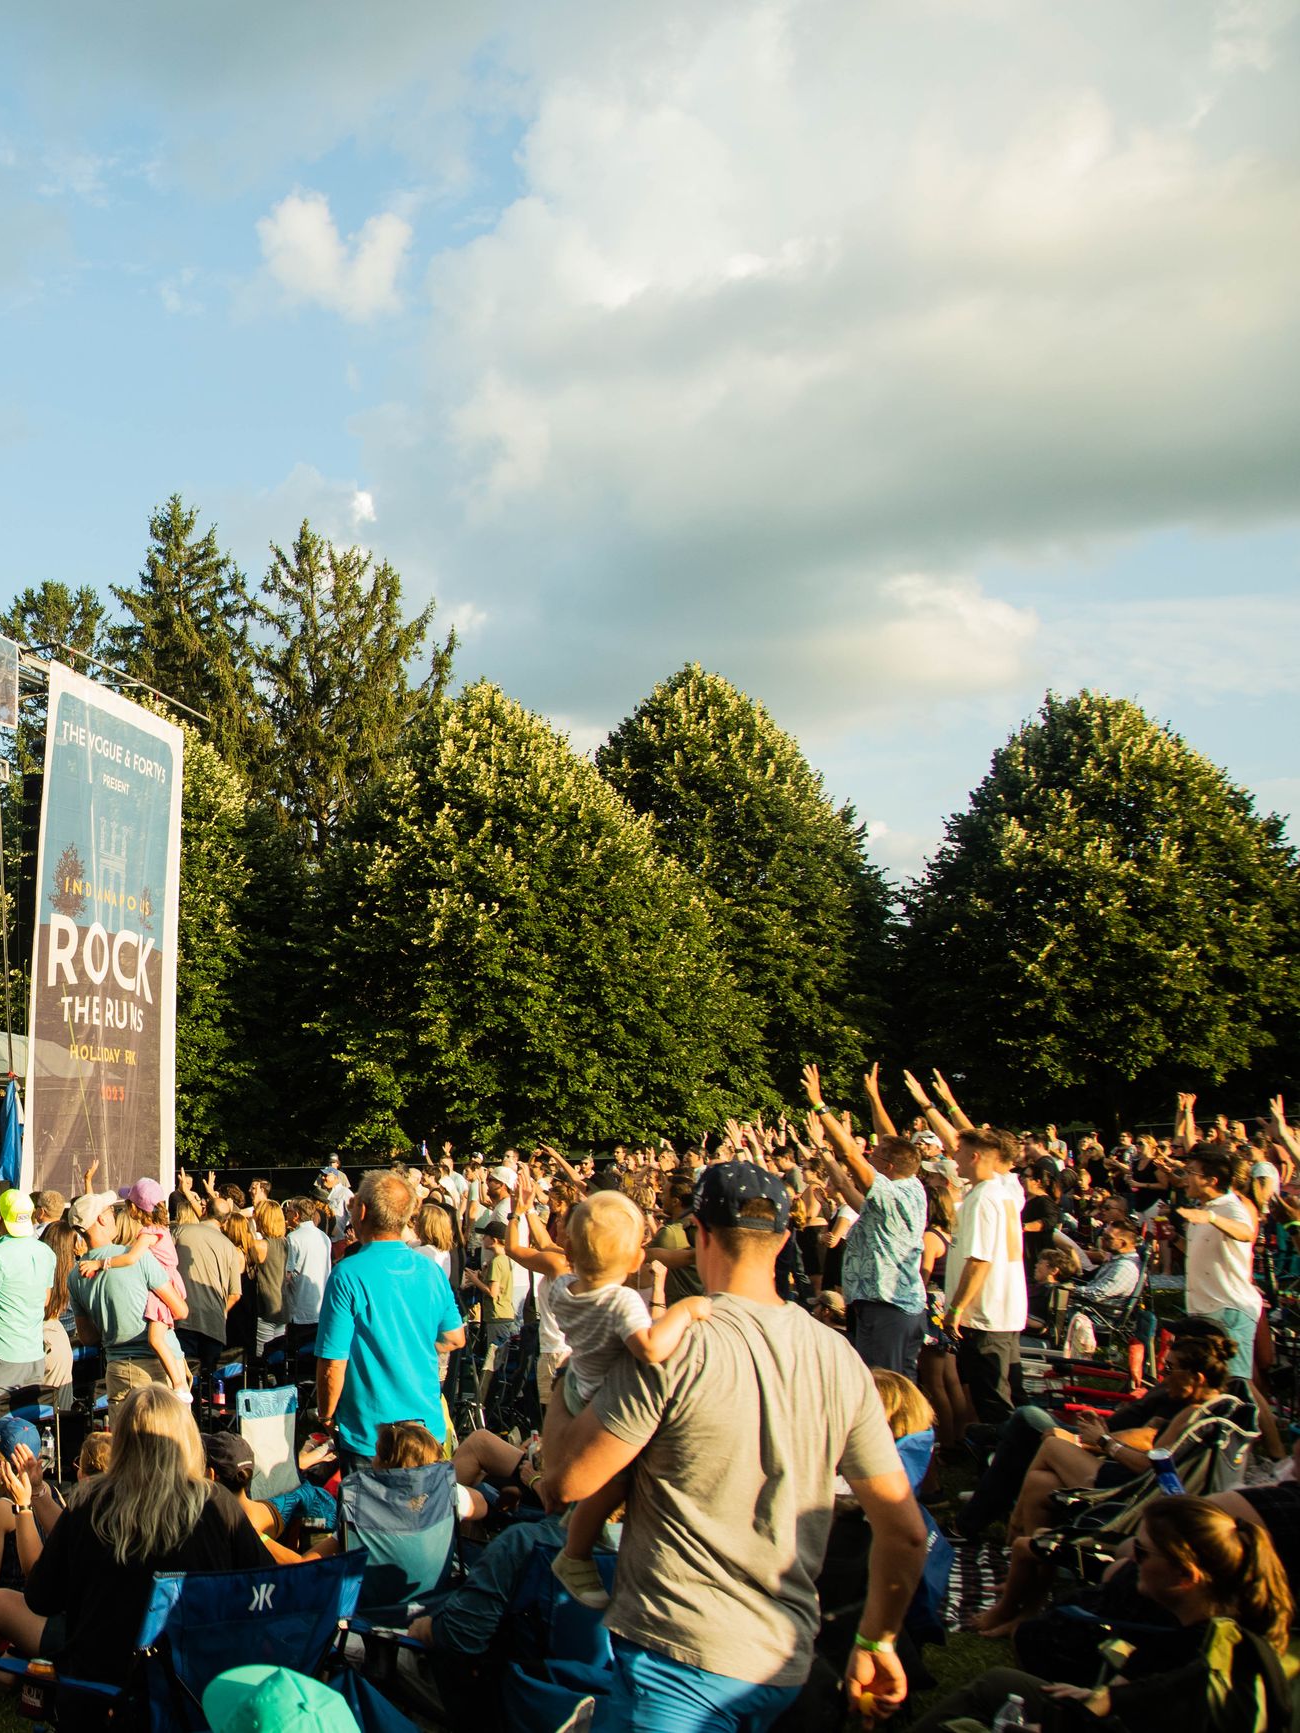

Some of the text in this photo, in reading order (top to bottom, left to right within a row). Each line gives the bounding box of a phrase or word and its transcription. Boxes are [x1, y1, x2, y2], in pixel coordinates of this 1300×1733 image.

[62, 720, 86, 747] THE
[88, 732, 123, 764] VOGUE
[124, 748, 131, 768] &
[102, 774, 130, 795] PRESENT
[47, 912, 156, 1005] ROCK
[60, 995, 144, 1033] THE RUNS
